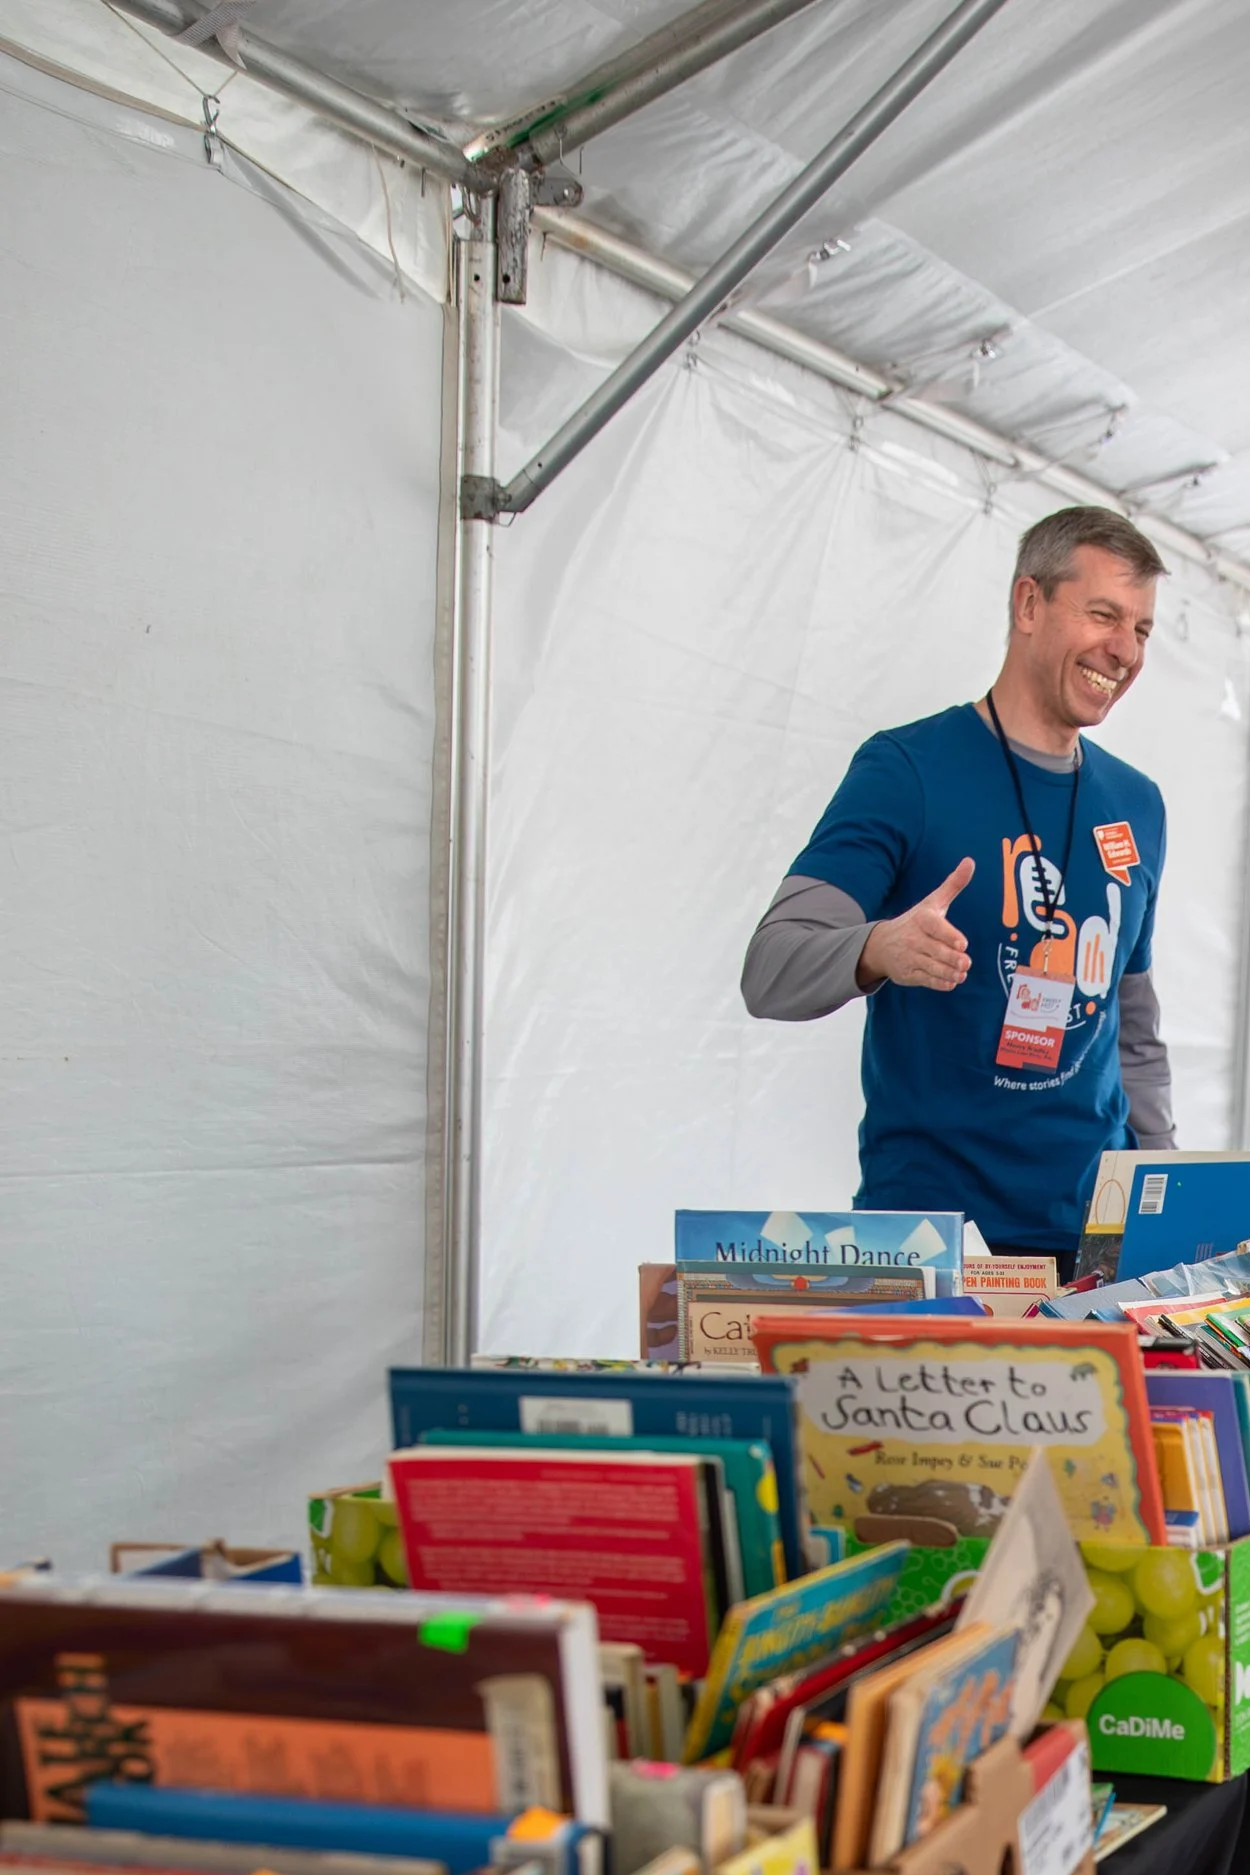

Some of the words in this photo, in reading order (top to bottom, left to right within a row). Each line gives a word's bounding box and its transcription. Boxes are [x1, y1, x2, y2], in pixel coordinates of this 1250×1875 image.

[1004, 1030, 1056, 1048] SPONSOR
[993, 1075, 1028, 1091] Where
[1029, 1078, 1060, 1091] stories
[714, 1239, 831, 1264] Midnight
[840, 1244, 921, 1266] Dance
[980, 1276, 1021, 1288] PAINTING
[1023, 1277, 1047, 1289] BOOK
[704, 1347, 712, 1356] by
[713, 1347, 739, 1355] KELLY
[837, 1365, 863, 1391] A
[876, 1364, 997, 1398] Letter
[1009, 1366, 1047, 1399] to
[822, 1394, 956, 1433] Santa
[964, 1399, 1093, 1436] Claus
[875, 1450, 905, 1466] Rose
[911, 1451, 954, 1471] Impey
[958, 1453, 972, 1467] &
[978, 1454, 1002, 1469] Sue
[1099, 1714, 1185, 1741] CaDiMe
